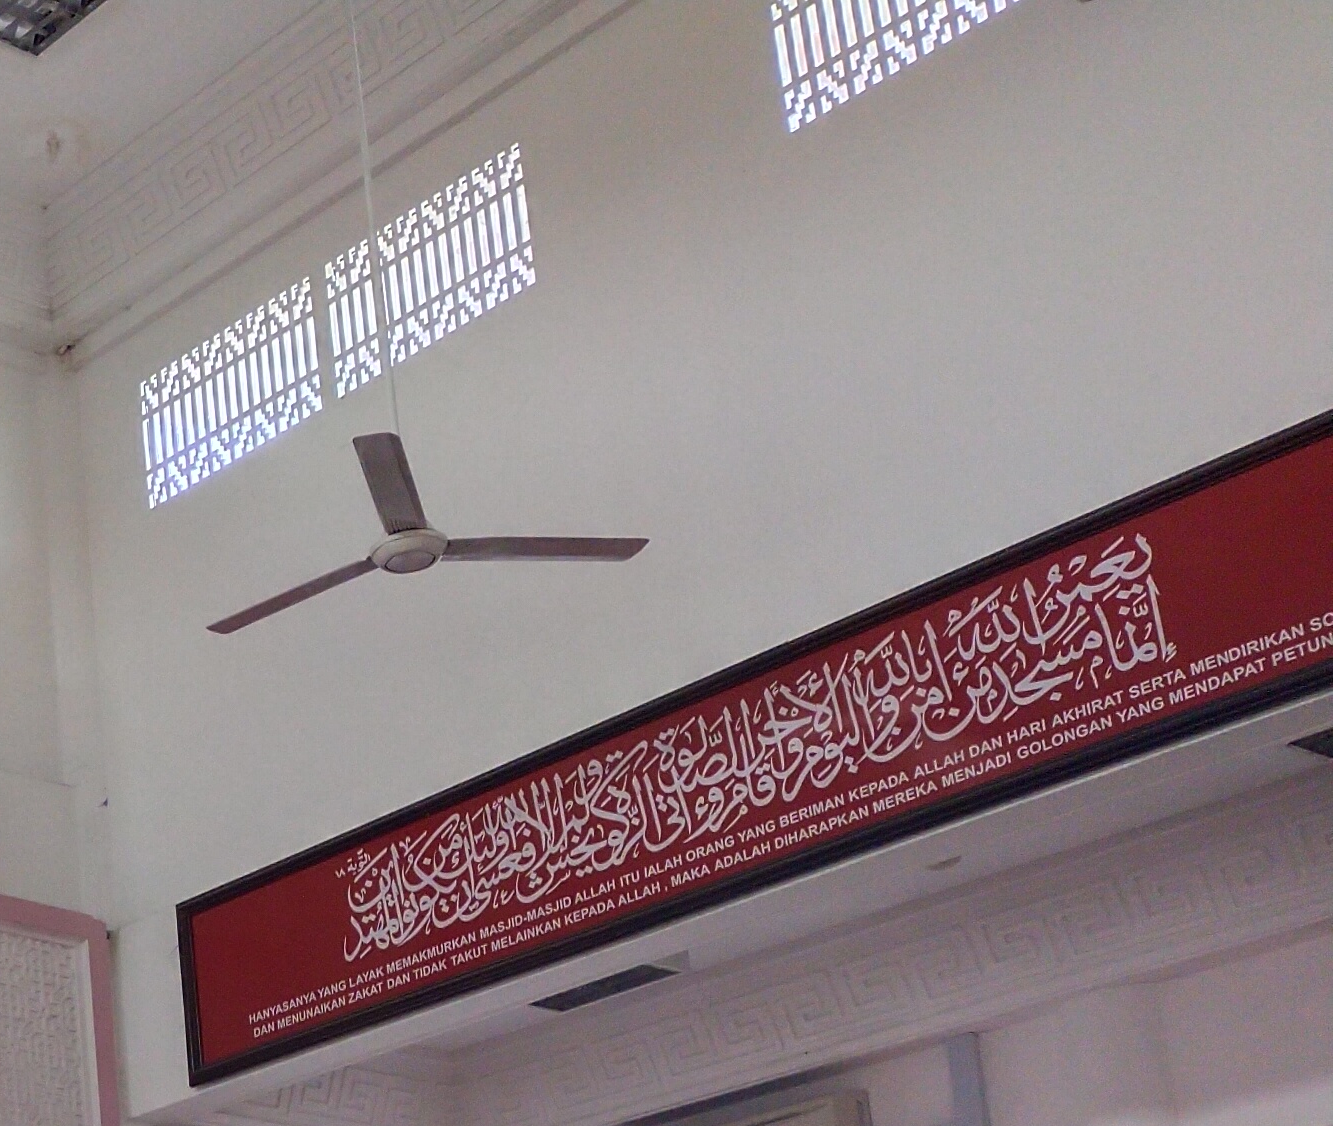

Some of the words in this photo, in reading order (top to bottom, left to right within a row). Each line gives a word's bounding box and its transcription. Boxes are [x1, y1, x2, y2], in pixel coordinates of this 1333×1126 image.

[249, 992, 316, 1024] HANYASANYA
[318, 981, 346, 998] YANG
[349, 967, 383, 987] LAYAK
[387, 932, 476, 974] MEMAKMURKAN
[480, 897, 571, 939] MASJID-MASJID
[575, 879, 615, 903] ALLAH
[620, 871, 639, 887] ITU
[645, 855, 682, 877] IALAH
[686, 836, 734, 861] ORANG
[738, 821, 775, 842] YANG
[780, 794, 844, 827] BERIMAN
[849, 772, 909, 801] KEPADA
[914, 750, 964, 779] ALLAH
[969, 736, 1002, 758] DAN
[1007, 719, 1046, 744] HARI
[1053, 691, 1123, 727] AKHIRAT
[1129, 669, 1186, 698] SERTA
[1190, 624, 1304, 675] MENDIRIKAN
[254, 1022, 274, 1037] DAN
[278, 996, 345, 1029] MENUNAIKAN
[349, 982, 382, 1003] ZAKAT
[387, 973, 410, 989] DAN
[414, 959, 446, 979] TIDAK
[451, 944, 487, 965] TAKUT
[492, 918, 560, 951] MELAINKAN
[565, 899, 615, 925] KEPADA
[619, 882, 660, 906] ALLAH
[671, 865, 710, 887] MAKA
[715, 841, 770, 871] ADALAH
[775, 806, 869, 849] DIHARAPKAN
[873, 781, 937, 813] MEREKA
[942, 752, 1011, 787] MENJADI
[1017, 715, 1112, 758] GOLONGAN
[1116, 697, 1164, 722] YANG
[1169, 658, 1265, 704] MENDAPAT
